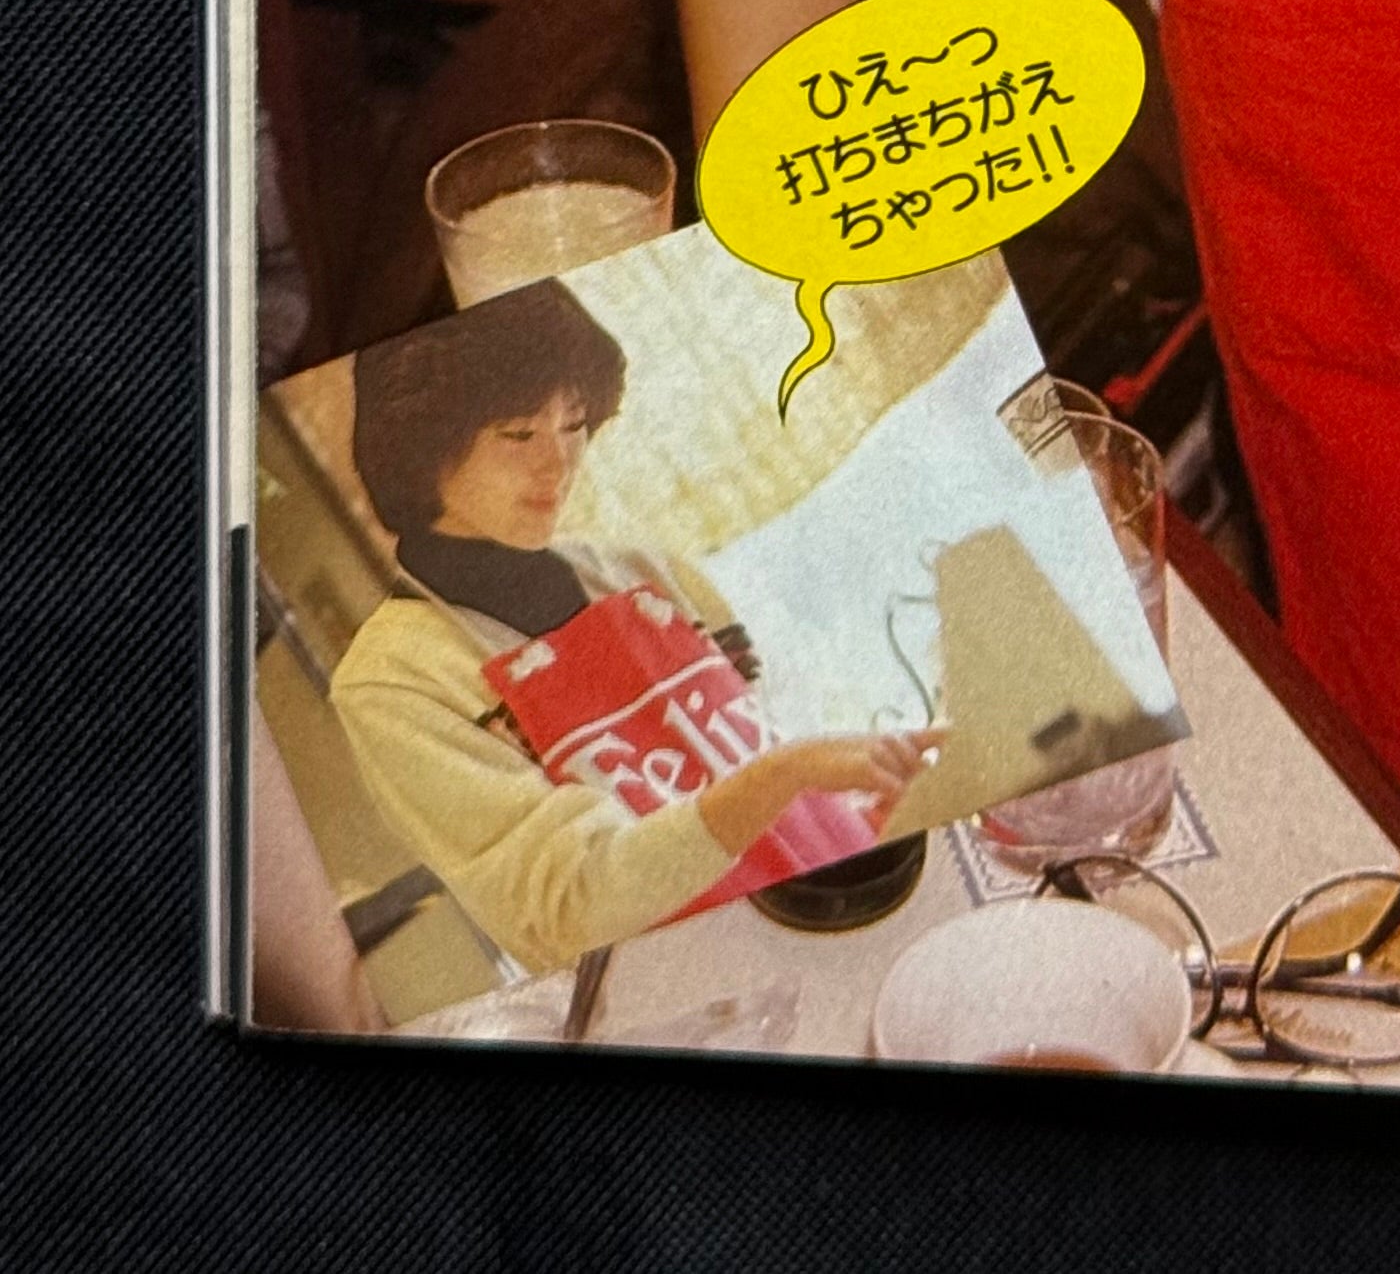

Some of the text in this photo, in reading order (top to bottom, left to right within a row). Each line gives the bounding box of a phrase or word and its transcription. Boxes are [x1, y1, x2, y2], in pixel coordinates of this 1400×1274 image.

[776, 61, 1074, 205] 打ちまちがえ
